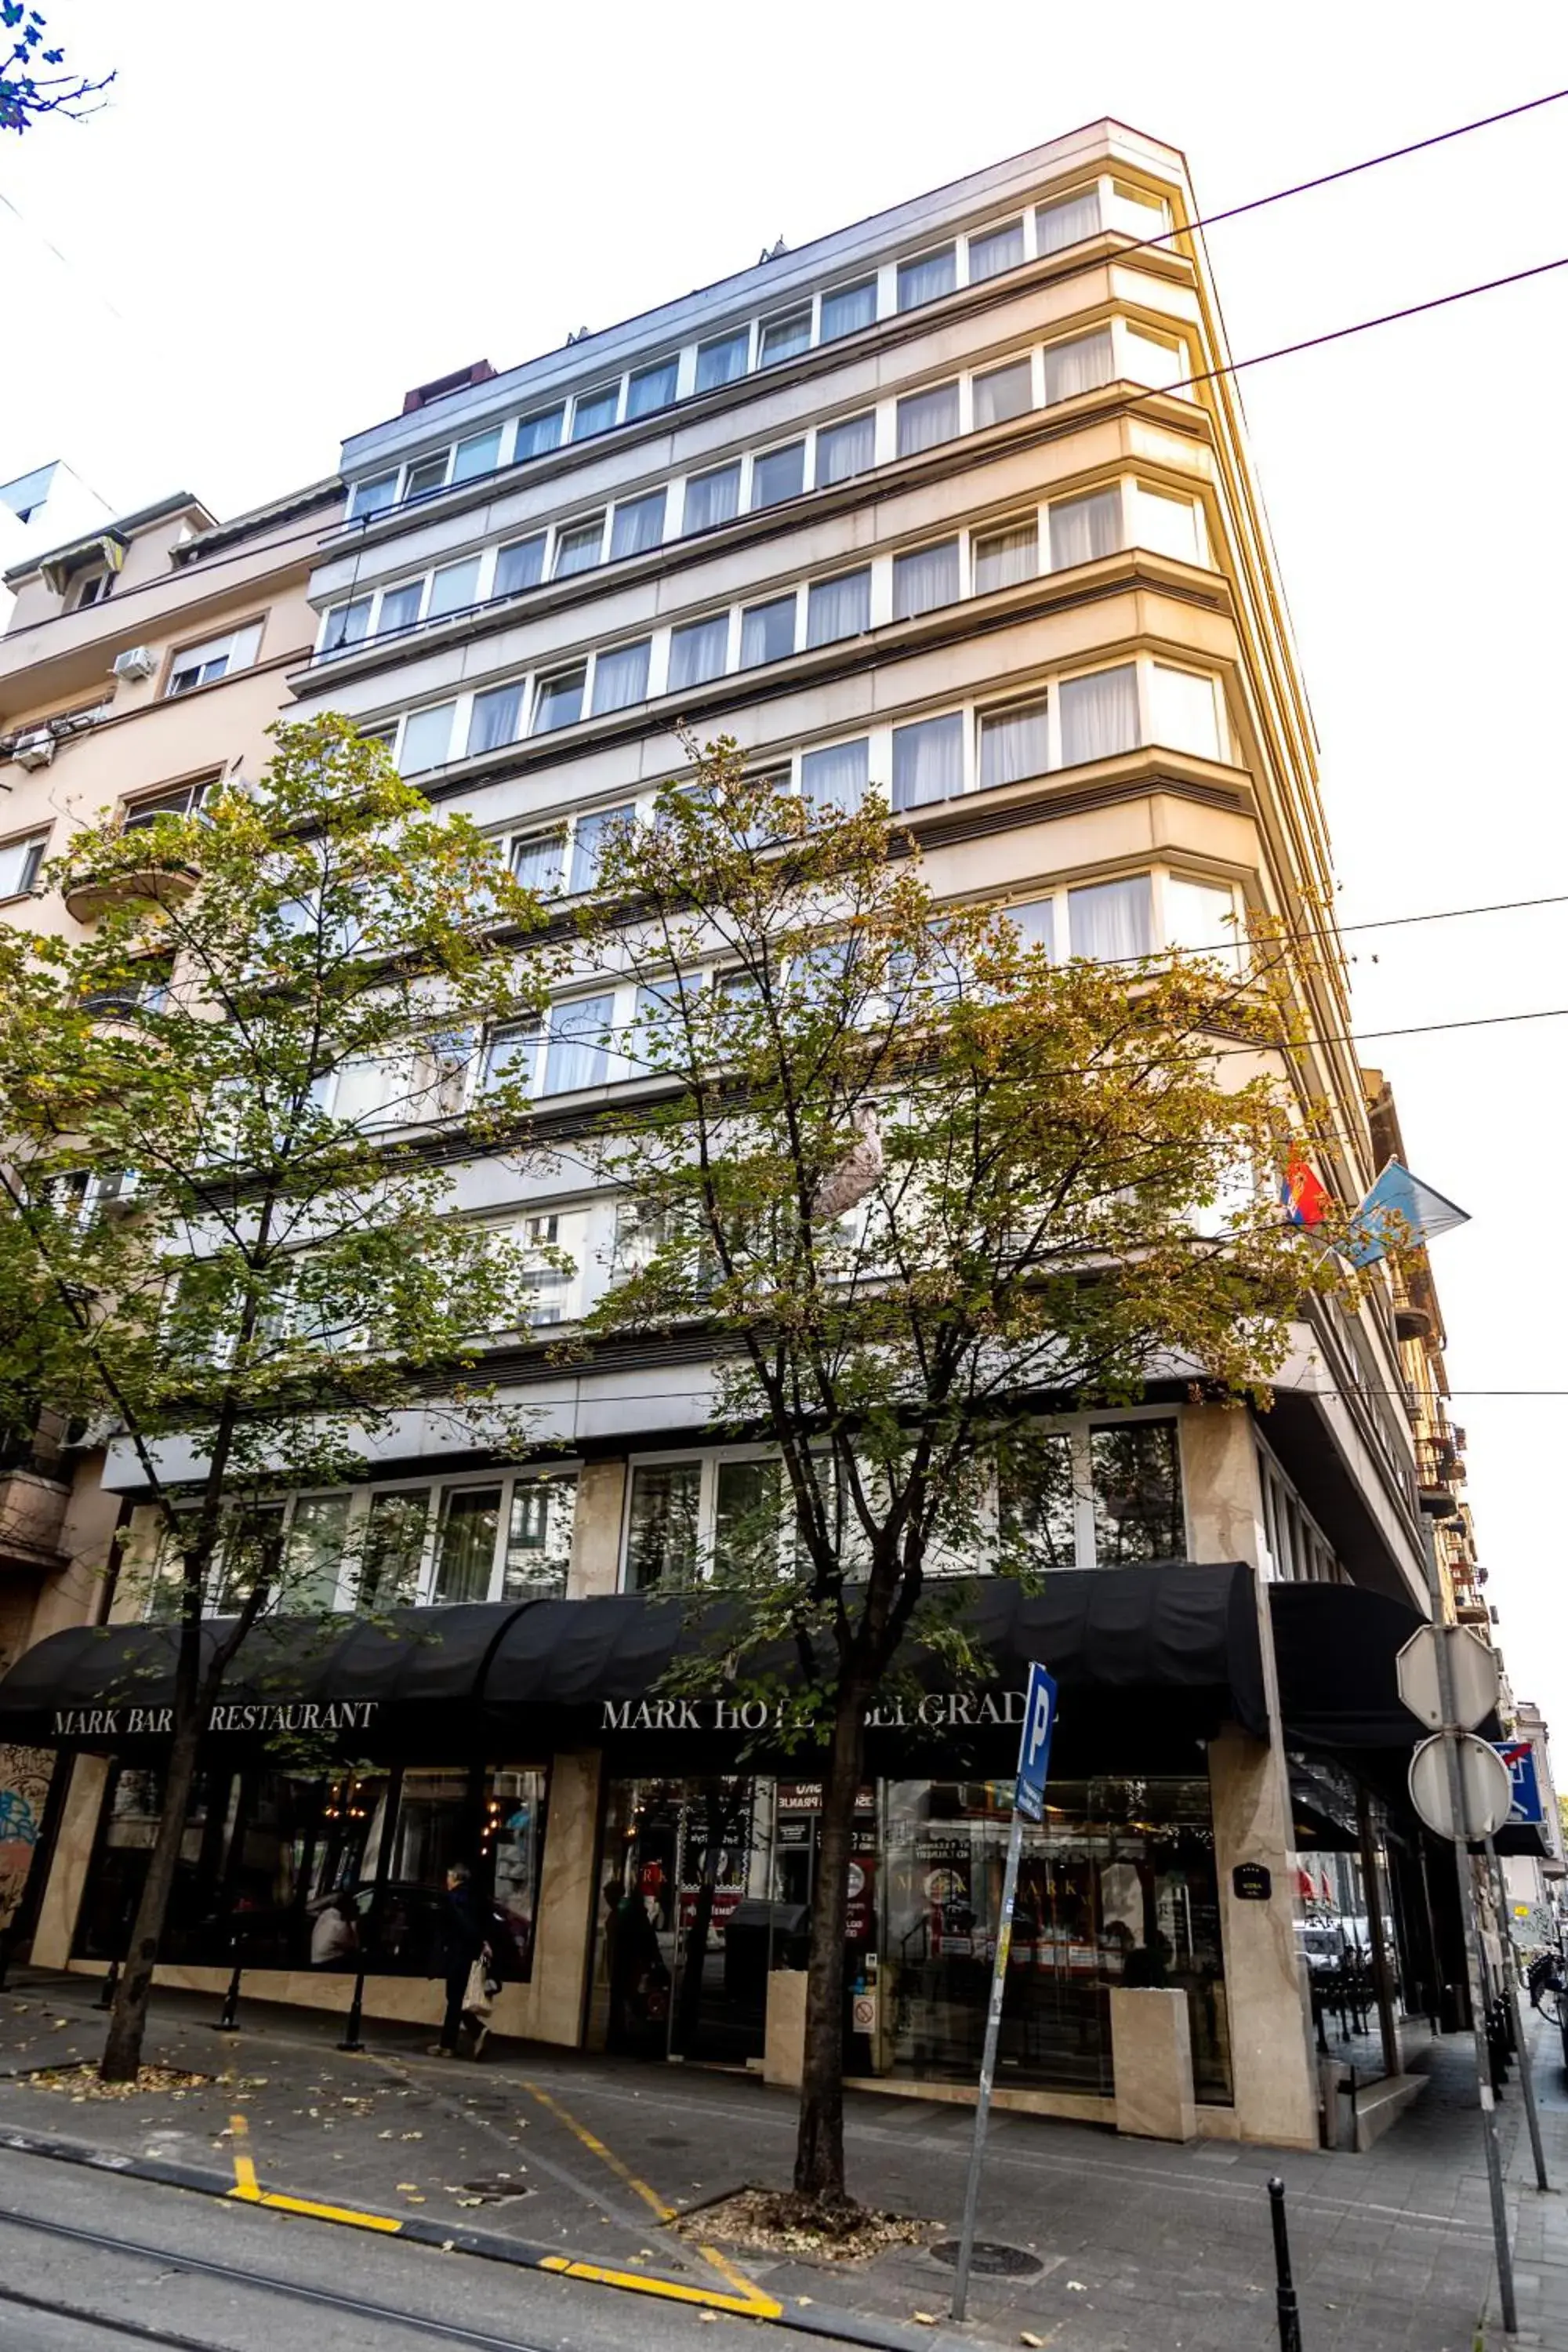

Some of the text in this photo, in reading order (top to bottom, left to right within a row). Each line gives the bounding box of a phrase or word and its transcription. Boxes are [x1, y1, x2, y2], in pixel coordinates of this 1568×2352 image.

[51, 1701, 379, 1735] MARK BAR RESTAURANT
[601, 1700, 702, 1729] MARK
[1028, 1684, 1050, 1766] P
